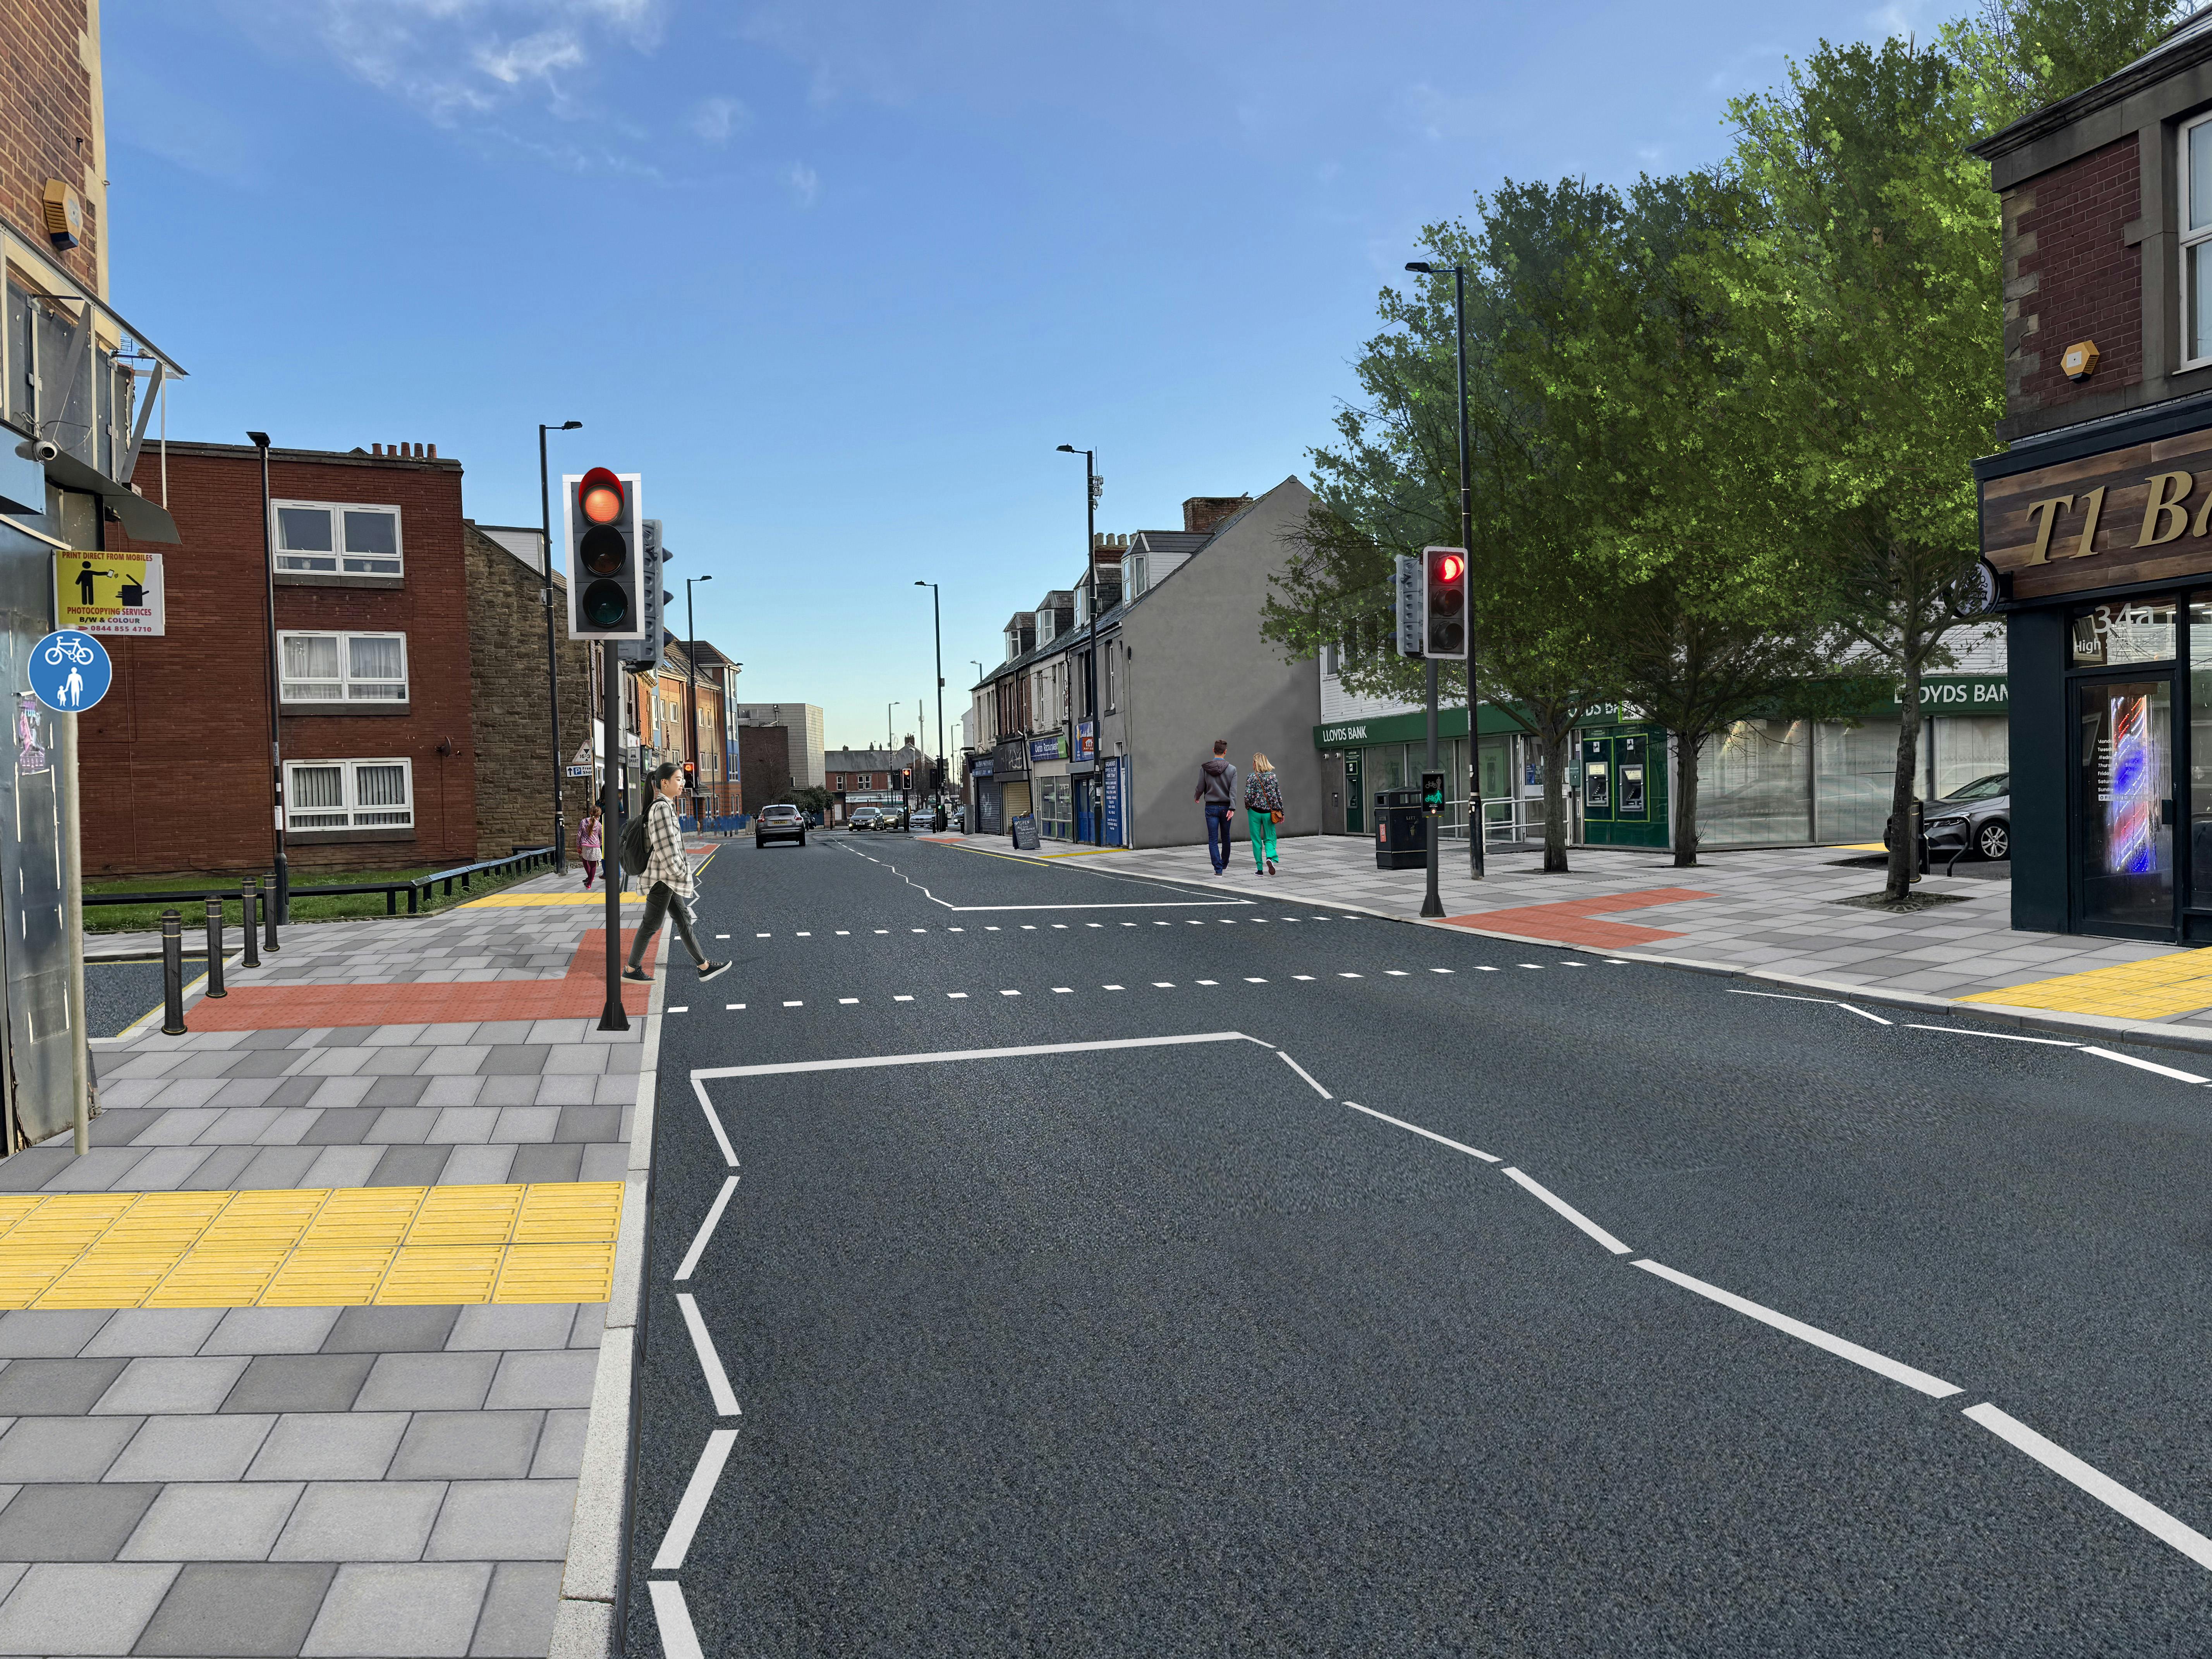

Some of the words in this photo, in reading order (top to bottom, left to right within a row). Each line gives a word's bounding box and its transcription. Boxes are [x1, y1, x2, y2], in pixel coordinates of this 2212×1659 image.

[2025, 486, 2105, 567] T1
[67, 606, 120, 615] PHOTOCOPYING
[2094, 603, 2154, 634] 34a
[2074, 638, 2101, 654] High
[1894, 685, 1967, 704] LOYDS
[1974, 684, 2008, 702] BAN
[1323, 728, 1346, 742] LLOYDS
[1348, 726, 1367, 740] BANK
